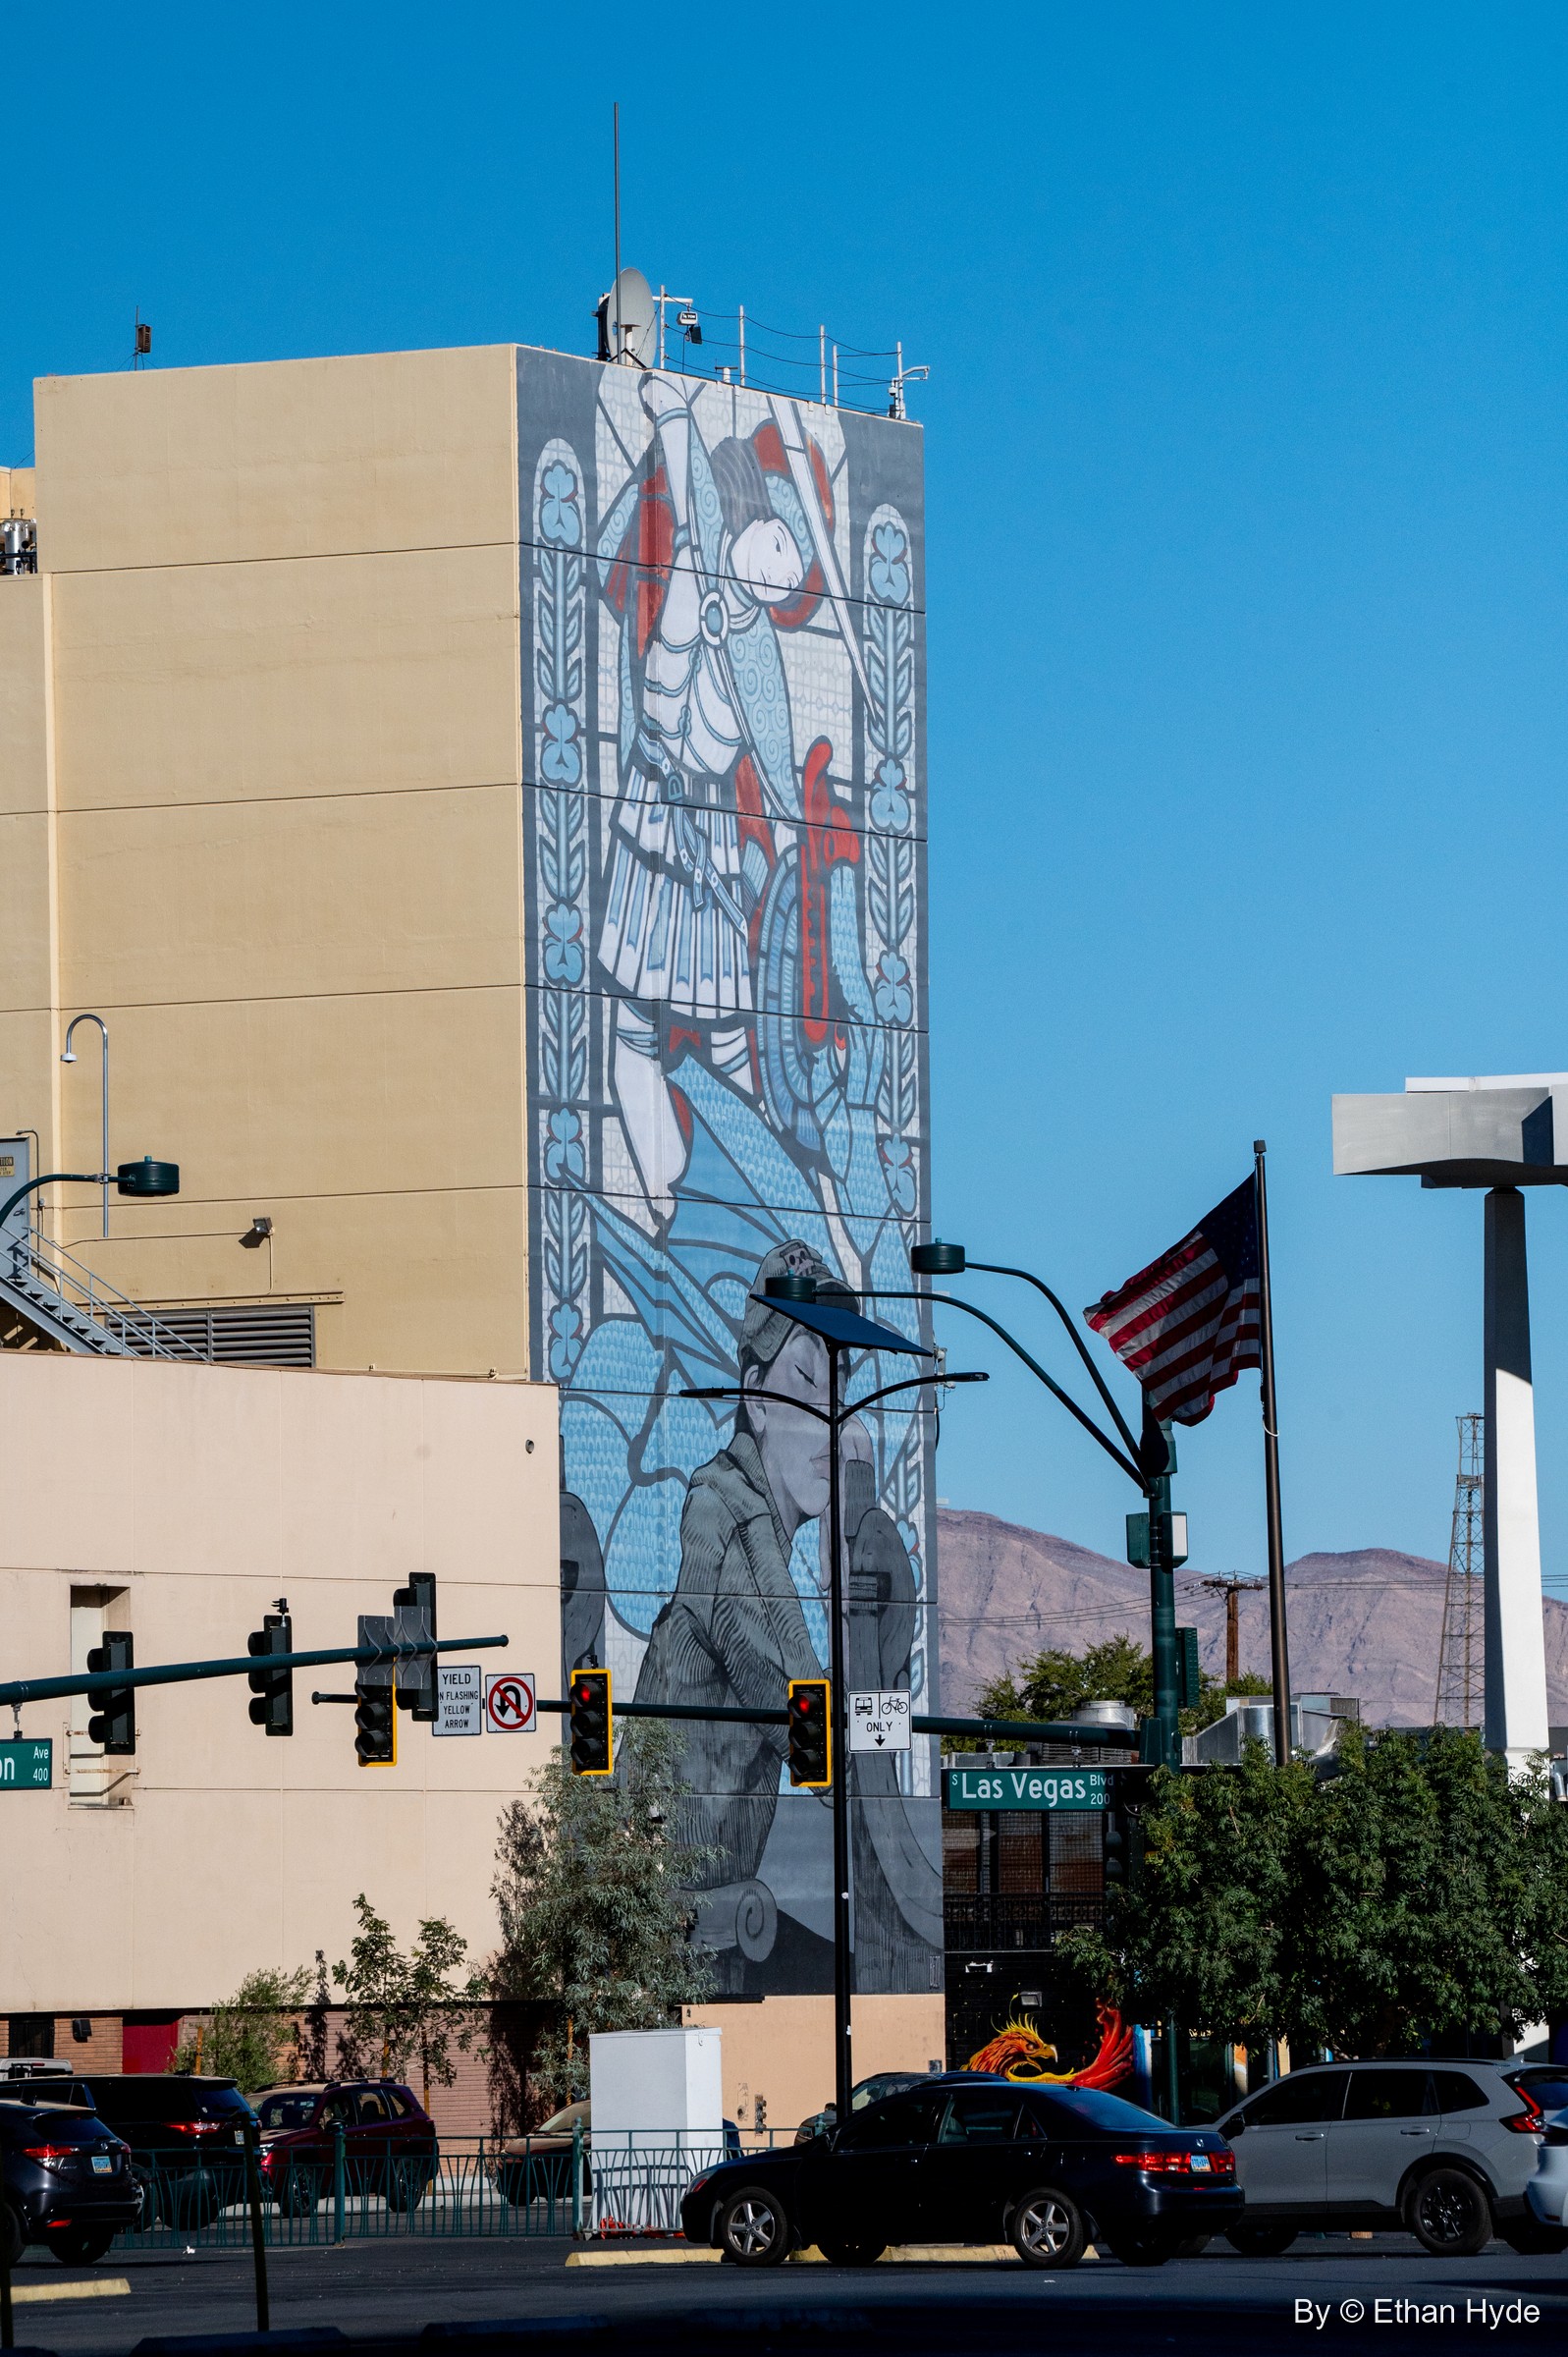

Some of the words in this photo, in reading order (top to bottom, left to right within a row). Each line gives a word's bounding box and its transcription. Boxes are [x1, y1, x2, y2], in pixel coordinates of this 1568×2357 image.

[442, 1673, 471, 1685] YIELD
[446, 1690, 479, 1701] FLASHING
[443, 1705, 471, 1715] YELLOW
[445, 1719, 469, 1728] ARROW
[866, 1721, 892, 1732] ONLY
[32, 1745, 49, 1759] Ave
[32, 1767, 49, 1781] 400
[951, 1774, 958, 1786] S
[962, 1773, 1003, 1799] Las
[1010, 1773, 1086, 1808] Vegas
[1090, 1774, 1114, 1786] Blvd
[1090, 1792, 1110, 1805] 200
